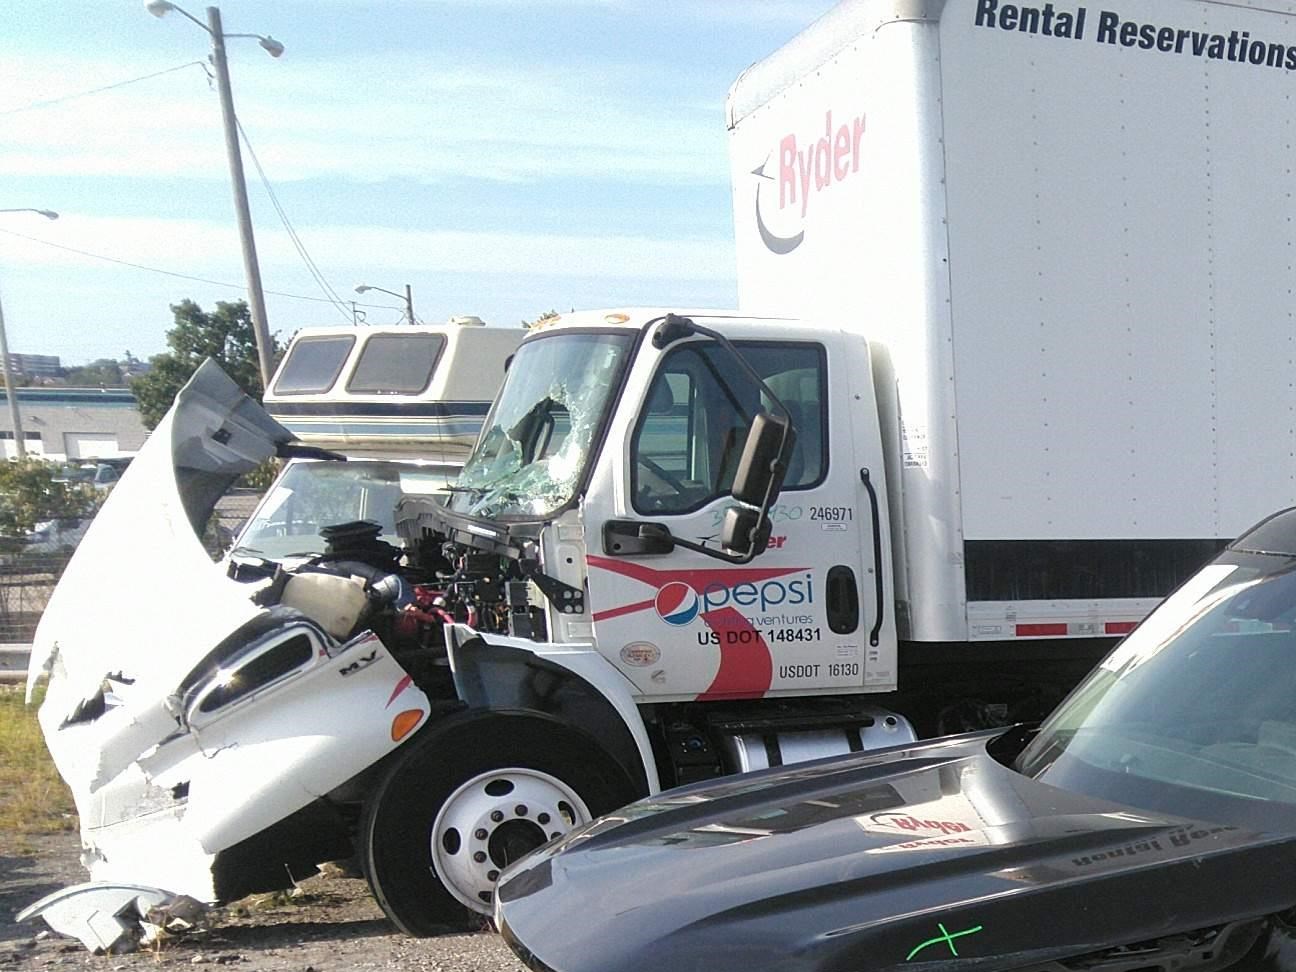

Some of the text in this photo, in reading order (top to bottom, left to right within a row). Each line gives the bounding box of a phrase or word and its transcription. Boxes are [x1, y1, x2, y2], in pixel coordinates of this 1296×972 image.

[974, 0, 1086, 40] Rental
[779, 109, 866, 218] Ryder
[809, 506, 853, 521] 246971
[703, 573, 813, 612] pepsi
[755, 614, 814, 627] ventures
[697, 627, 821, 646] US DOT 148431
[338, 649, 377, 677] MV
[779, 664, 821, 679] USDOT
[828, 663, 859, 677] 16130
